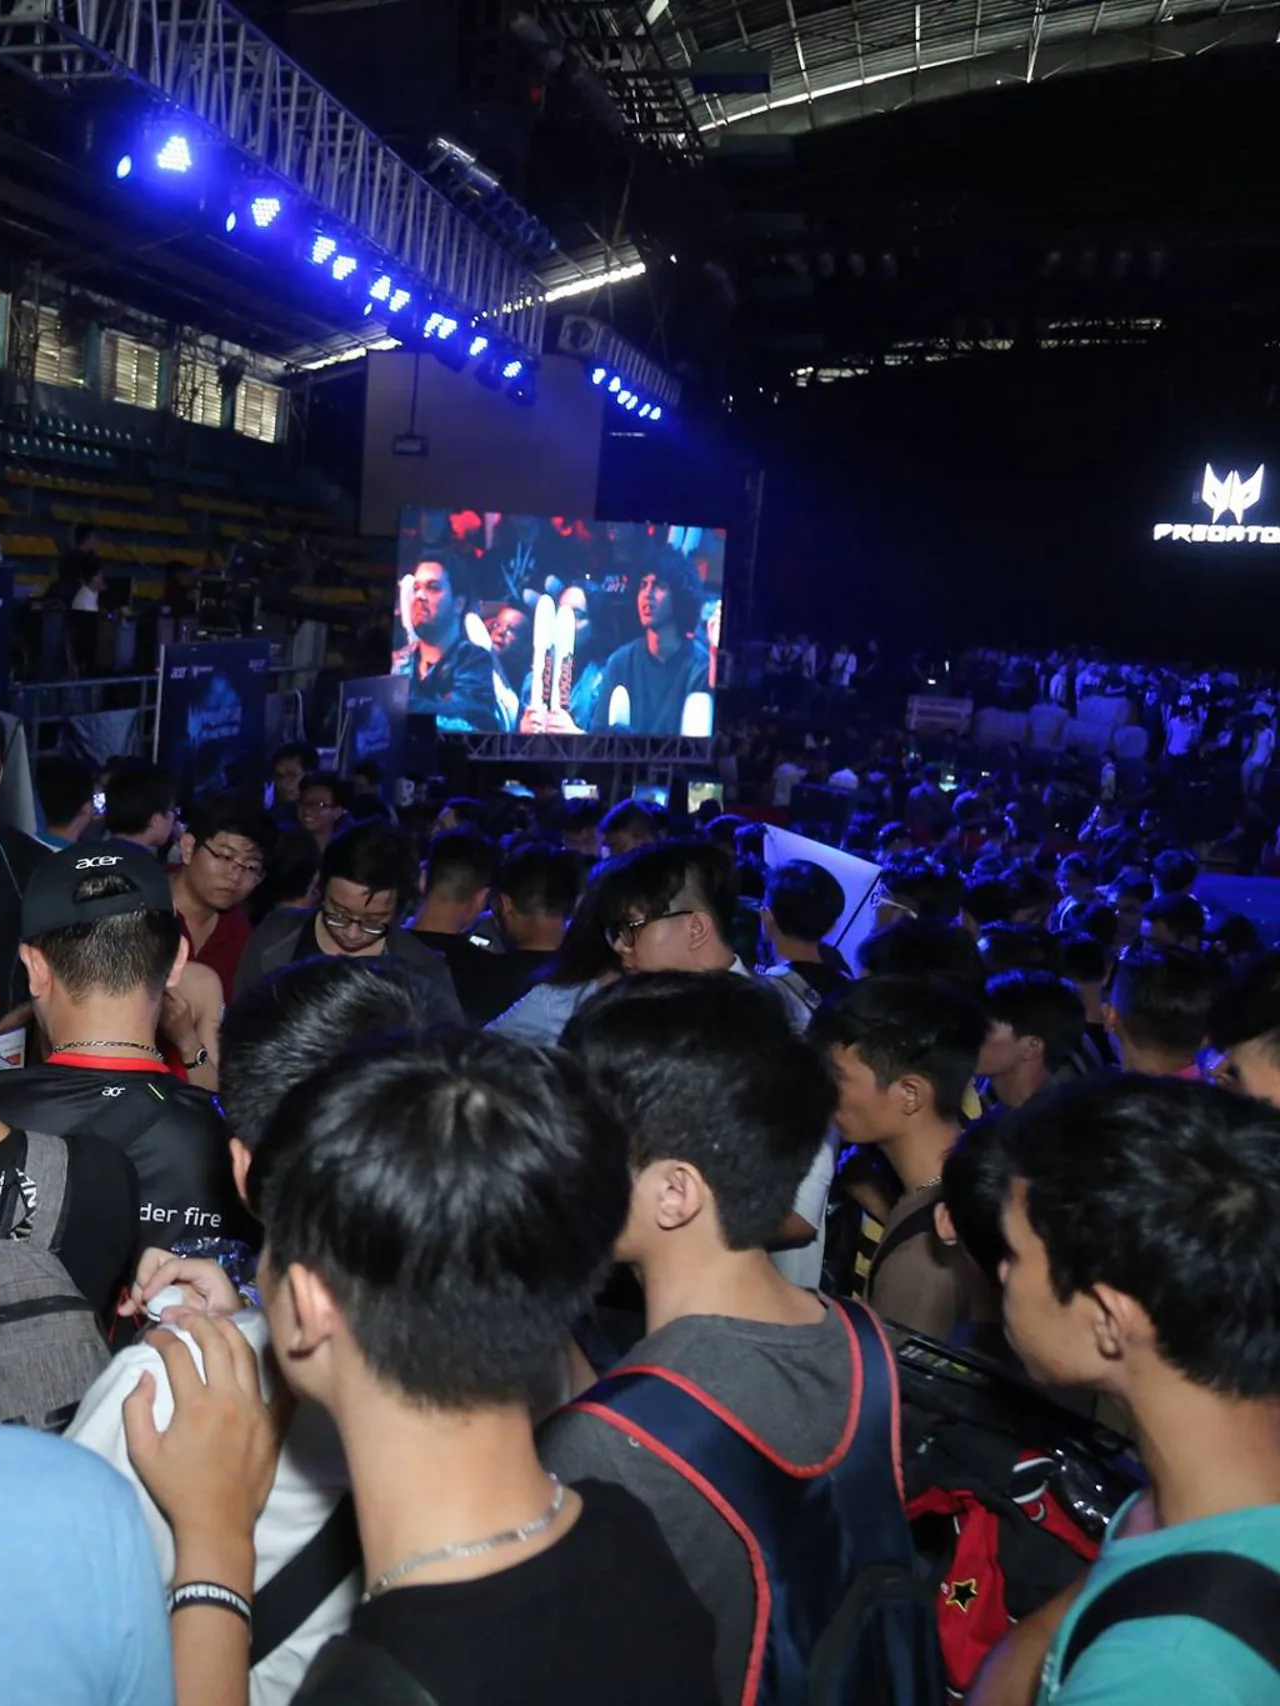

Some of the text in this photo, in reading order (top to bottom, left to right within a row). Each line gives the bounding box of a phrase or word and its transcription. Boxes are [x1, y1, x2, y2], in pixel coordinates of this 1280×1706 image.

[1153, 523, 1280, 544] PREDATO
[75, 856, 123, 870] acer
[184, 1206, 221, 1228] fire
